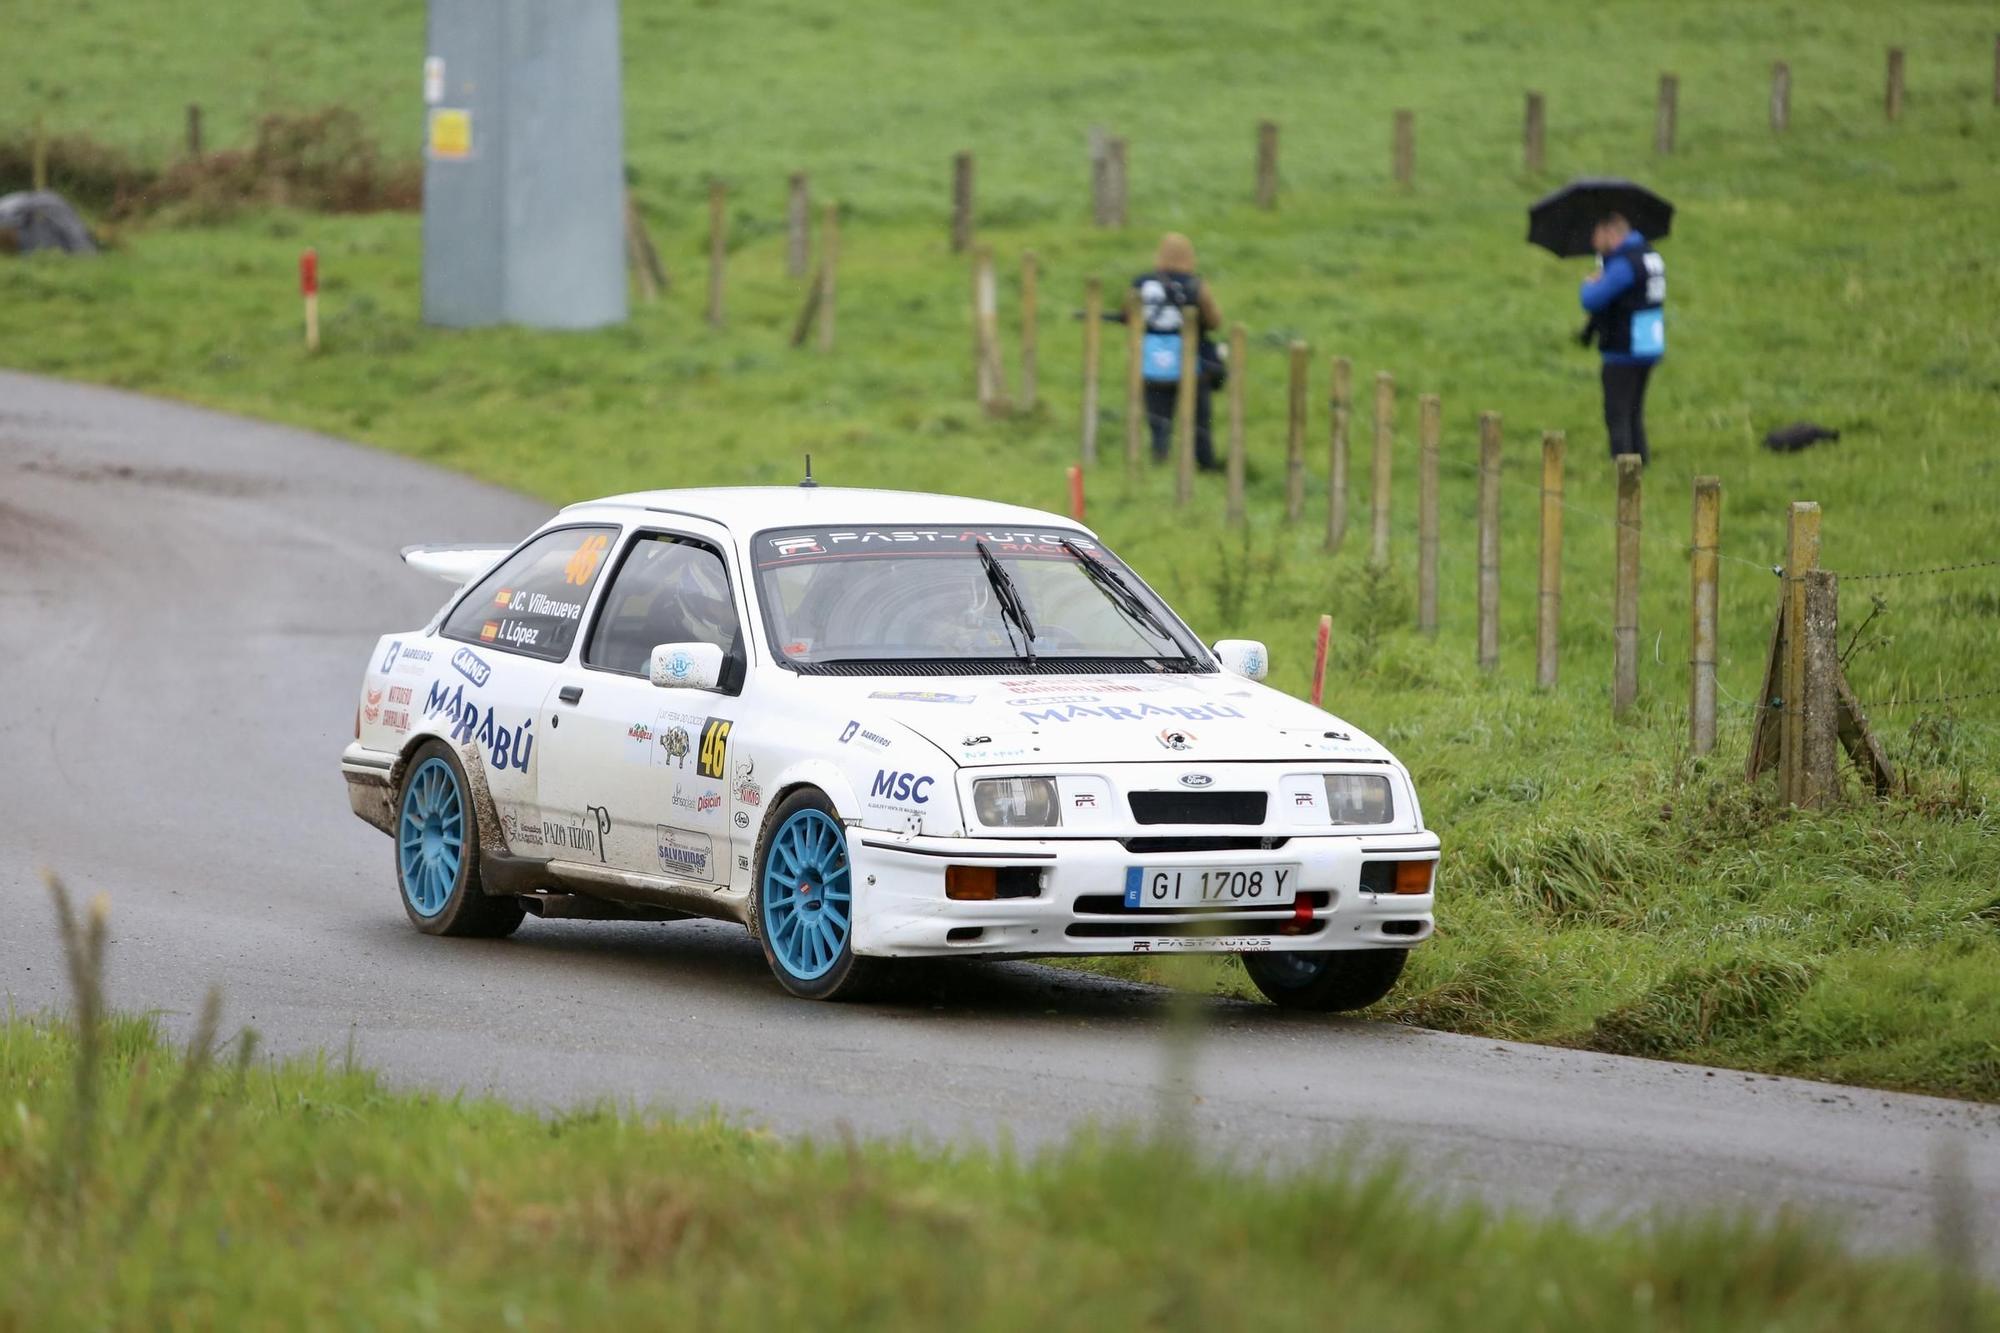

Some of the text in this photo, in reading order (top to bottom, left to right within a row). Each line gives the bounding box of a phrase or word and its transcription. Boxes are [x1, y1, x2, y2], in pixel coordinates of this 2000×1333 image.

[564, 535, 607, 586] 46
[509, 590, 582, 620] JC. Villanueva
[506, 621, 539, 645] López
[453, 650, 491, 685] CARNES
[424, 678, 533, 773] MARABÚ
[1019, 701, 1246, 725] MARABÚ
[701, 720, 730, 777] 46
[861, 729, 892, 748] BARREIROS
[870, 769, 935, 804] MSC
[1187, 774, 1208, 786] Ford
[543, 821, 566, 846] PAZO
[658, 845, 706, 868] SALVAVIDAS
[1129, 890, 1137, 899] E
[1152, 869, 1289, 900] GI 1708 Y
[1157, 937, 1272, 947] FAST-AUTOS
